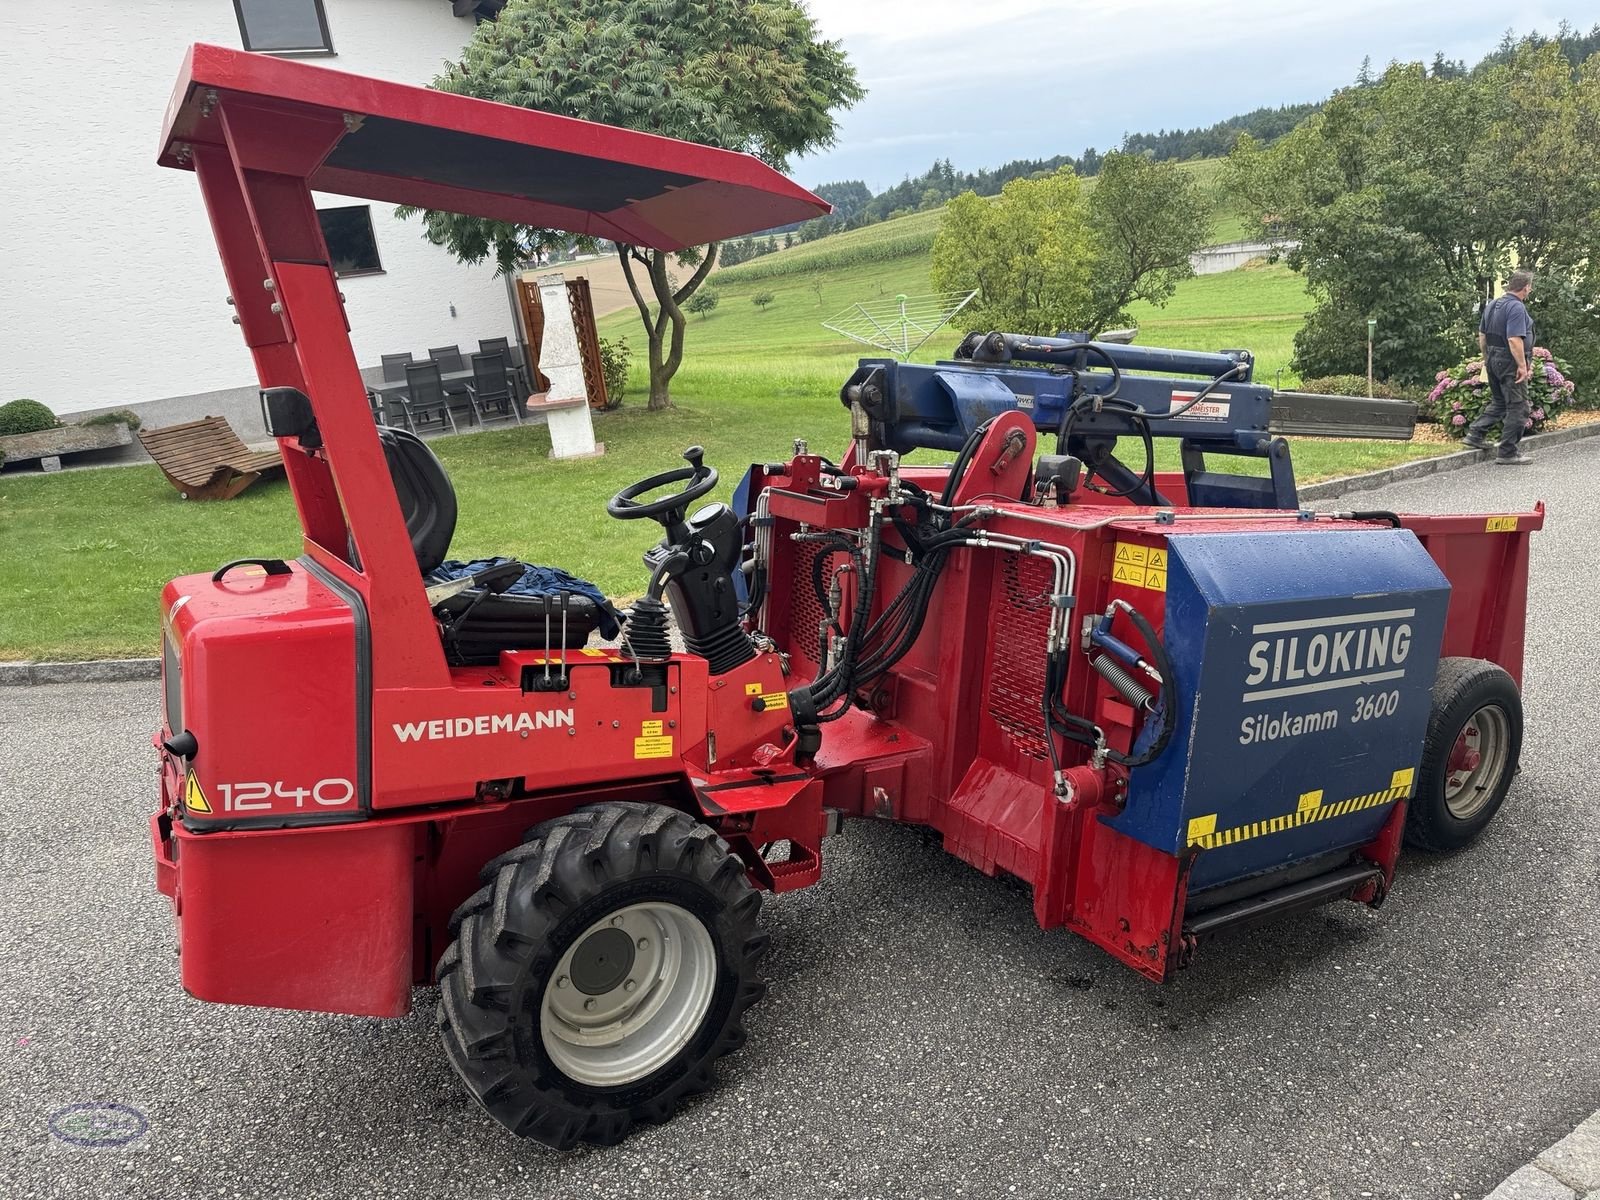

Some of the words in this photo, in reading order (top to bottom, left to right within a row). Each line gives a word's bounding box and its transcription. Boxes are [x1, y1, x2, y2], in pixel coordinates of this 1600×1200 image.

[1245, 623, 1412, 686] SILOKING
[392, 708, 575, 743] WEIDEMANN
[1239, 709, 1339, 745] Silokamm
[1351, 689, 1400, 724] 3600
[217, 778, 354, 812] 1240
